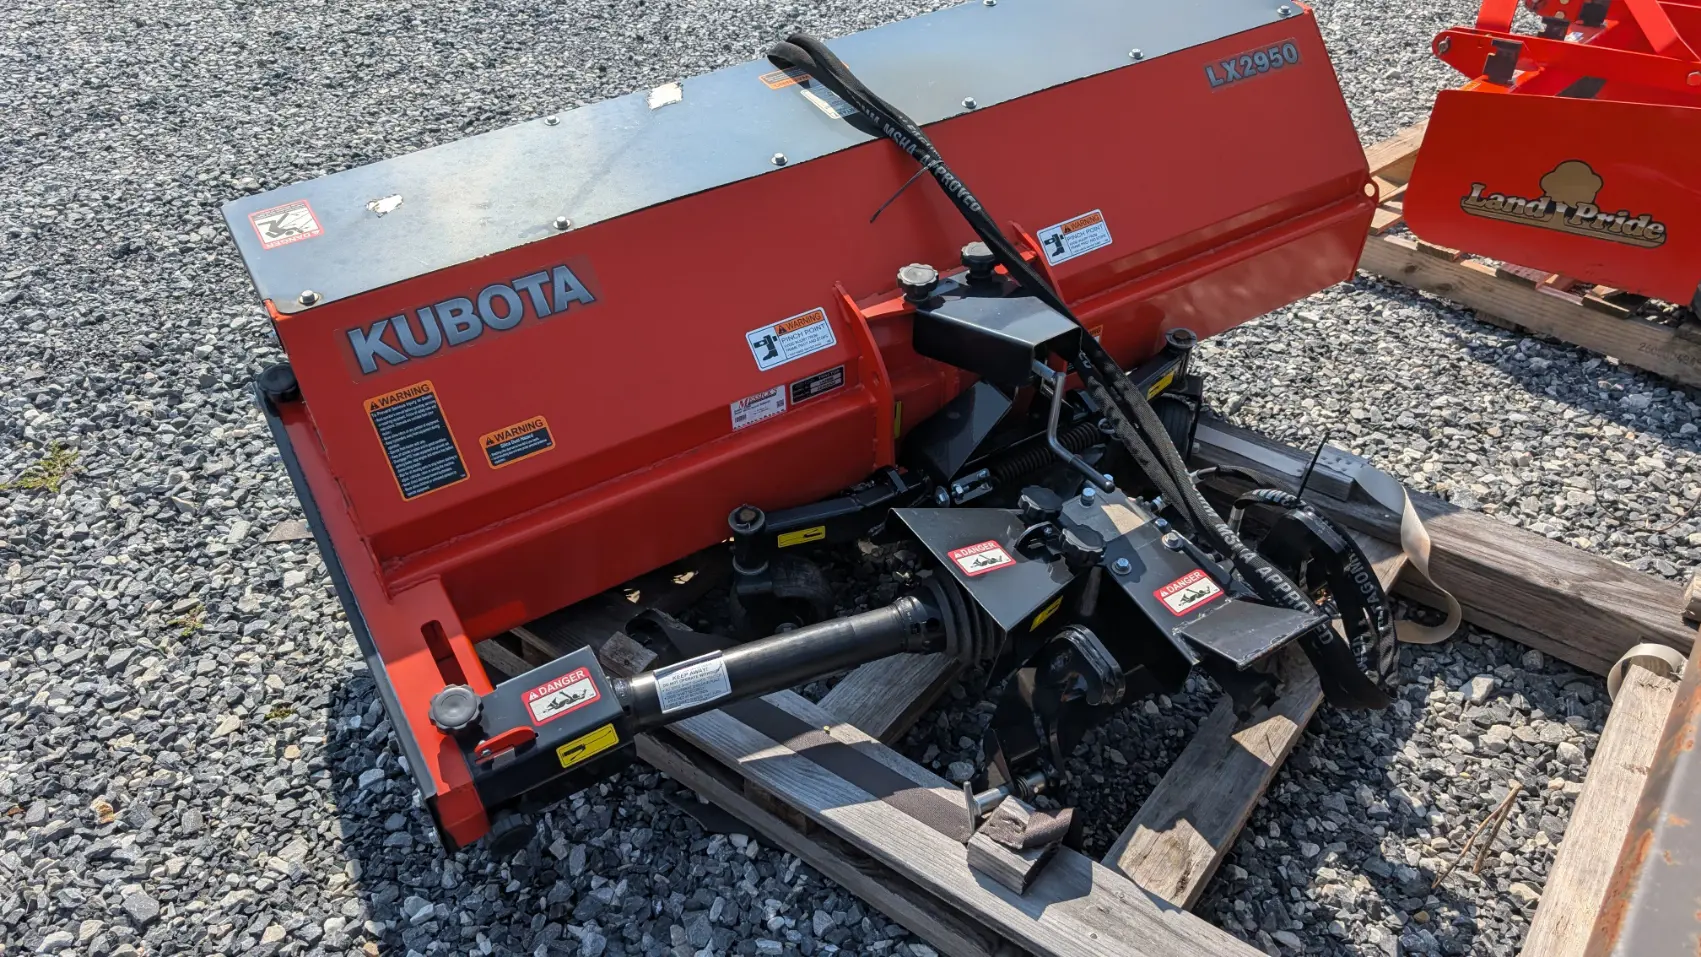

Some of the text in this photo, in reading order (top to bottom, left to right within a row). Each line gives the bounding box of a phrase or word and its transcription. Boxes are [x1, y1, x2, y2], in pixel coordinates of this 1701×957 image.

[1205, 43, 1299, 88] LX2950
[883, 123, 918, 155] MSHA
[1071, 214, 1099, 230] WARNING
[1463, 183, 1665, 240] Land Pride
[266, 232, 312, 248] DANGER
[346, 265, 597, 375] KUBOTA
[787, 312, 821, 329] WARNING
[781, 323, 825, 343] PINCH POINT
[378, 384, 430, 407] WARNING
[493, 419, 544, 443] WARNING
[961, 542, 997, 556] DANGER
[1166, 571, 1202, 593] DANGER
[1256, 566, 1334, 645] APPROED
[539, 671, 586, 695] DANGER
[672, 672, 689, 680] KEEP
